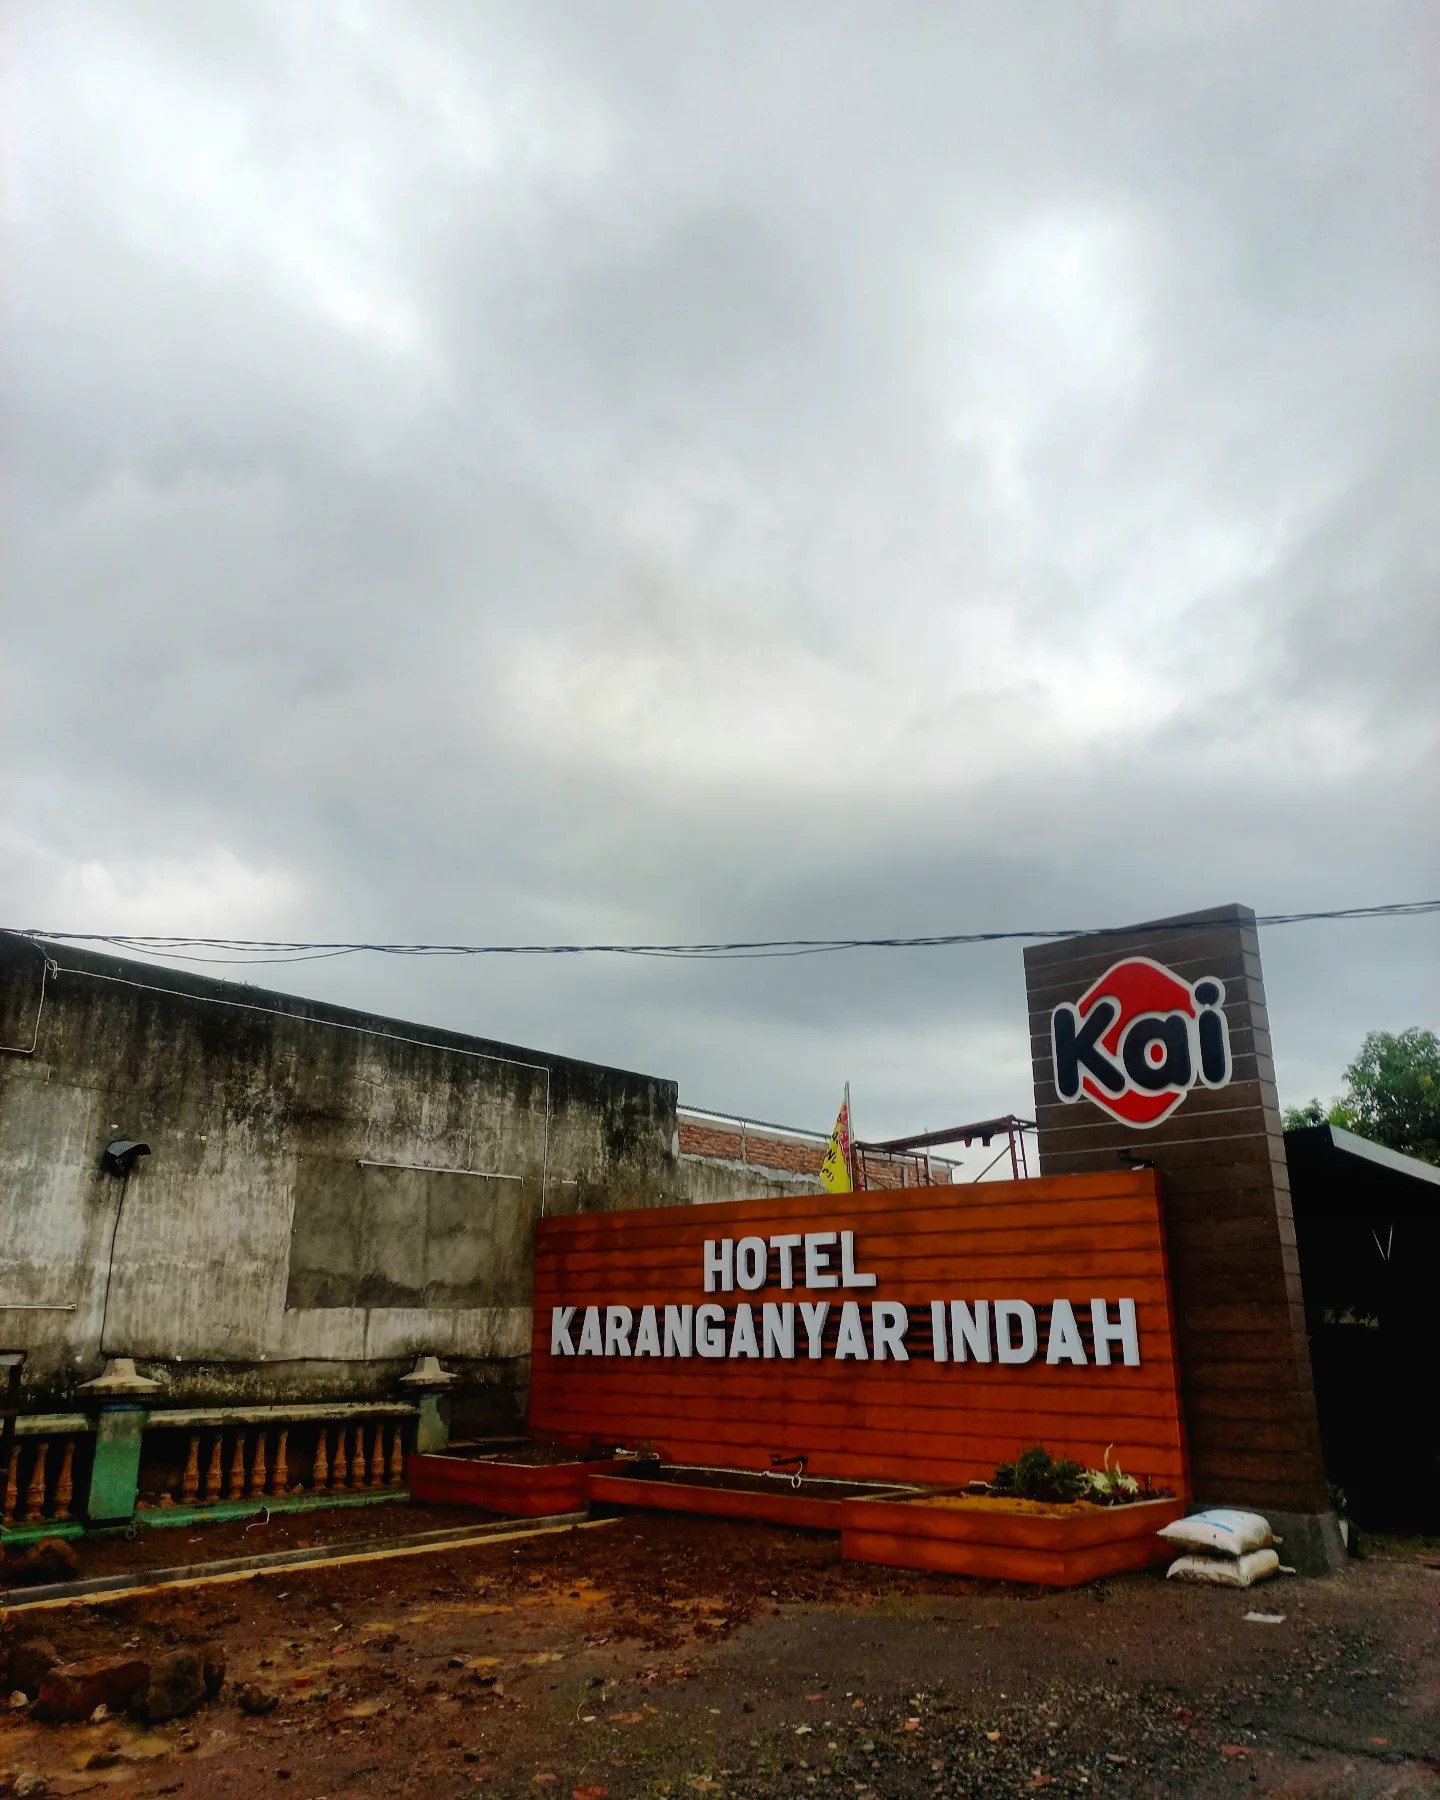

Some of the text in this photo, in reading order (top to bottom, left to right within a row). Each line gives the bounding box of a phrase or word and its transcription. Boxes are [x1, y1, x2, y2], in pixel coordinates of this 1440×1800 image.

[1053, 980, 1228, 1099] Kai
[703, 1230, 877, 1293] HOTEL
[551, 1298, 1140, 1366] KARANGANYAR INDAH
